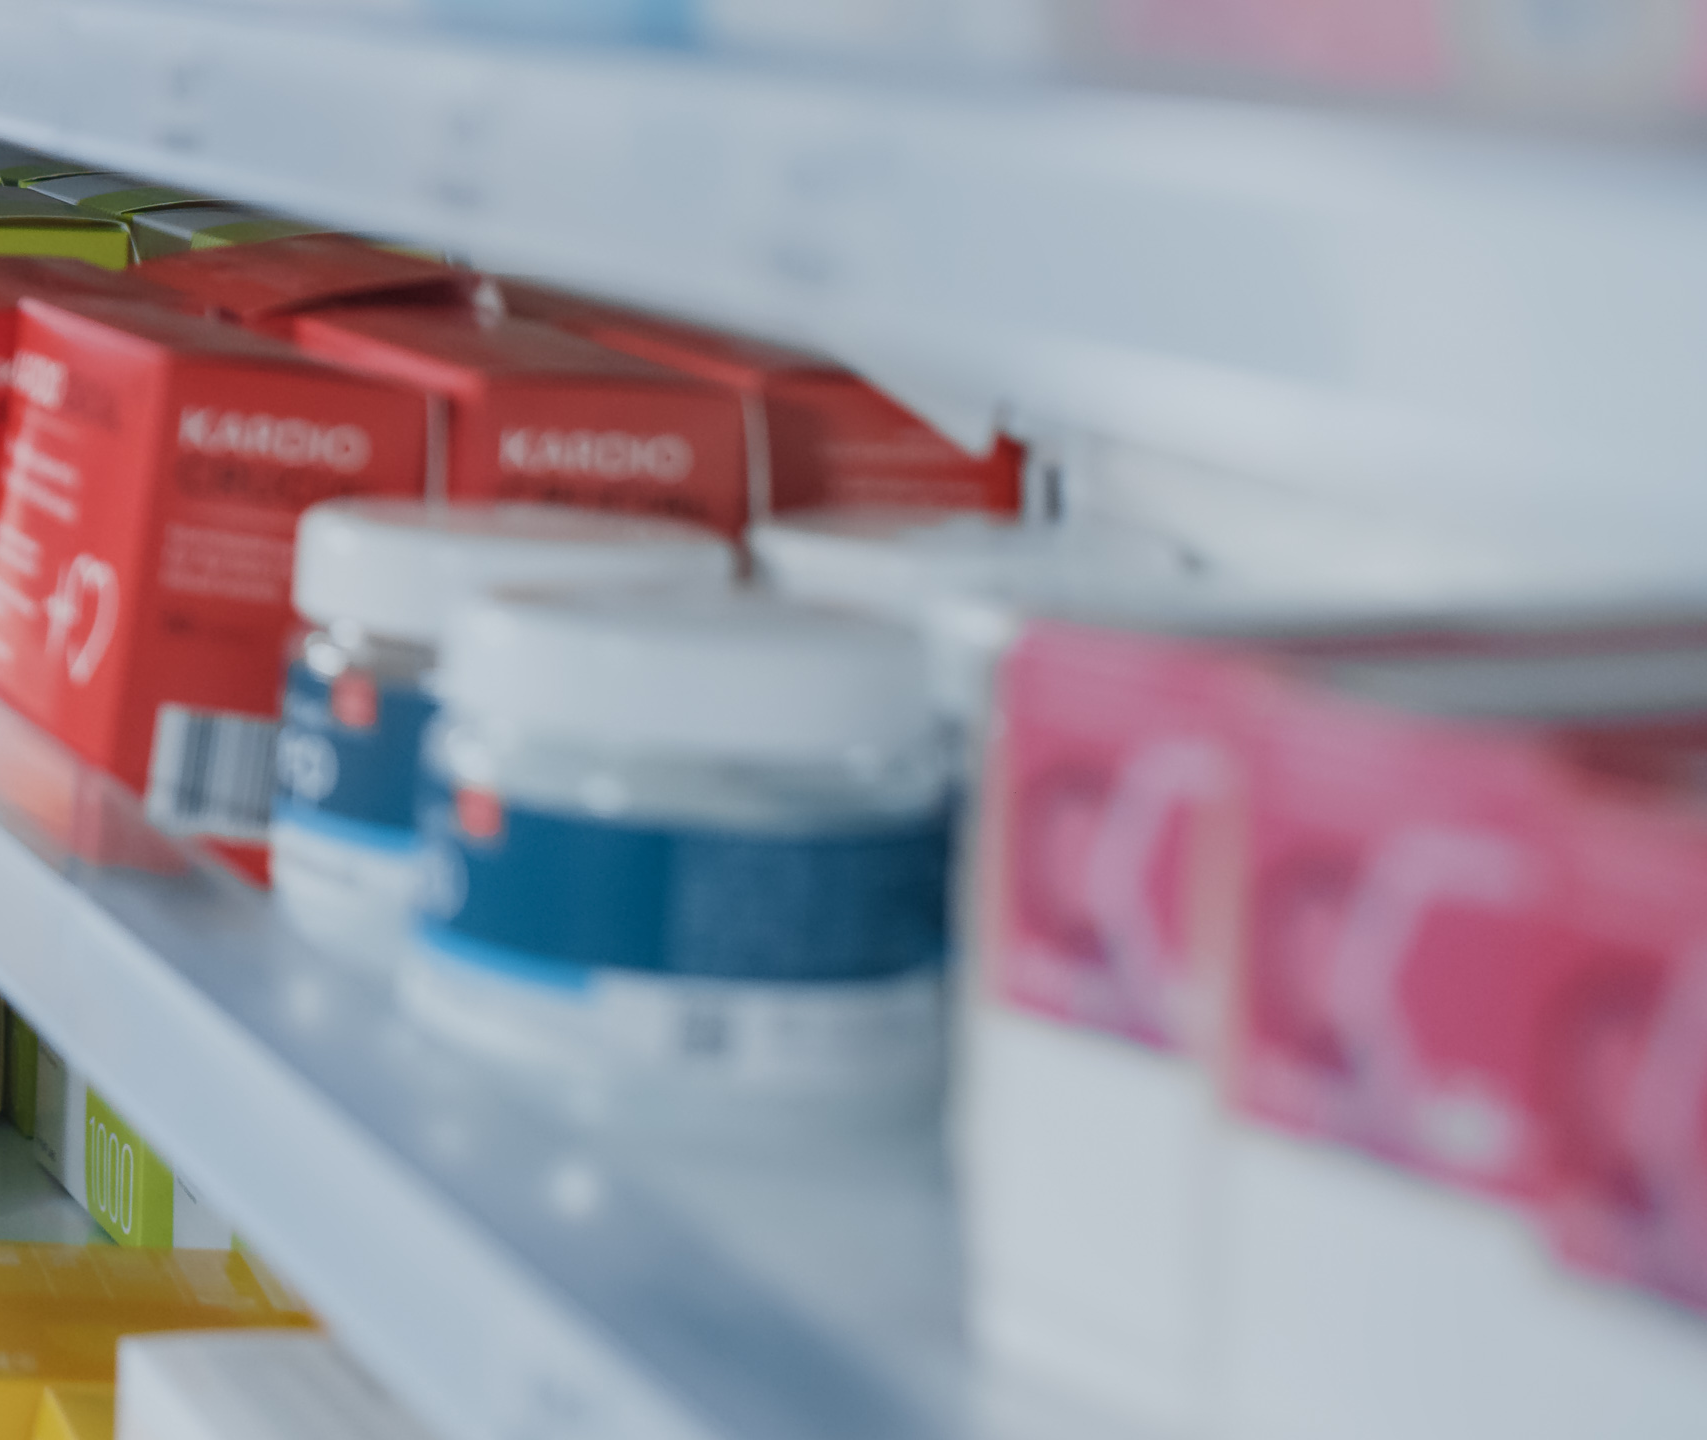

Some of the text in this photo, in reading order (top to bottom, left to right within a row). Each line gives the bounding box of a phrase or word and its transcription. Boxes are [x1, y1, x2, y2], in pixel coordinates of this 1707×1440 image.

[178, 406, 372, 472] KARDIO
[498, 426, 695, 482] KARDIO
[89, 1116, 134, 1235] 1000
